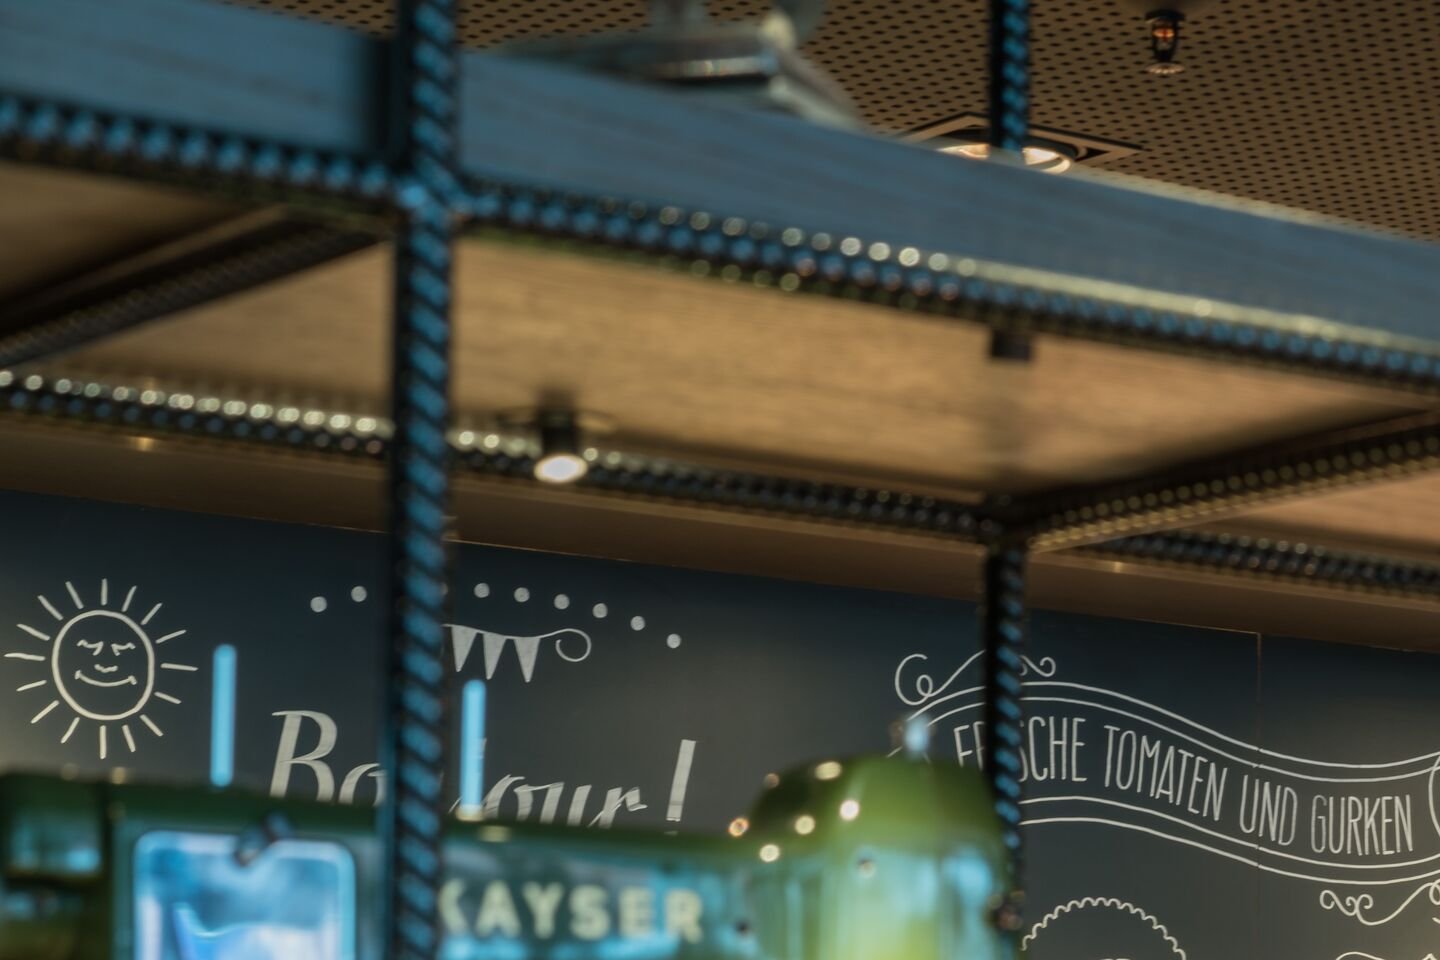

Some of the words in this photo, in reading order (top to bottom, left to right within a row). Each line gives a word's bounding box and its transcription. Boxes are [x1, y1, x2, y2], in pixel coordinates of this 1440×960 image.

[1103, 724, 1229, 822] TOMATEN
[1239, 773, 1298, 847] UND
[1310, 793, 1414, 856] GURKEN
